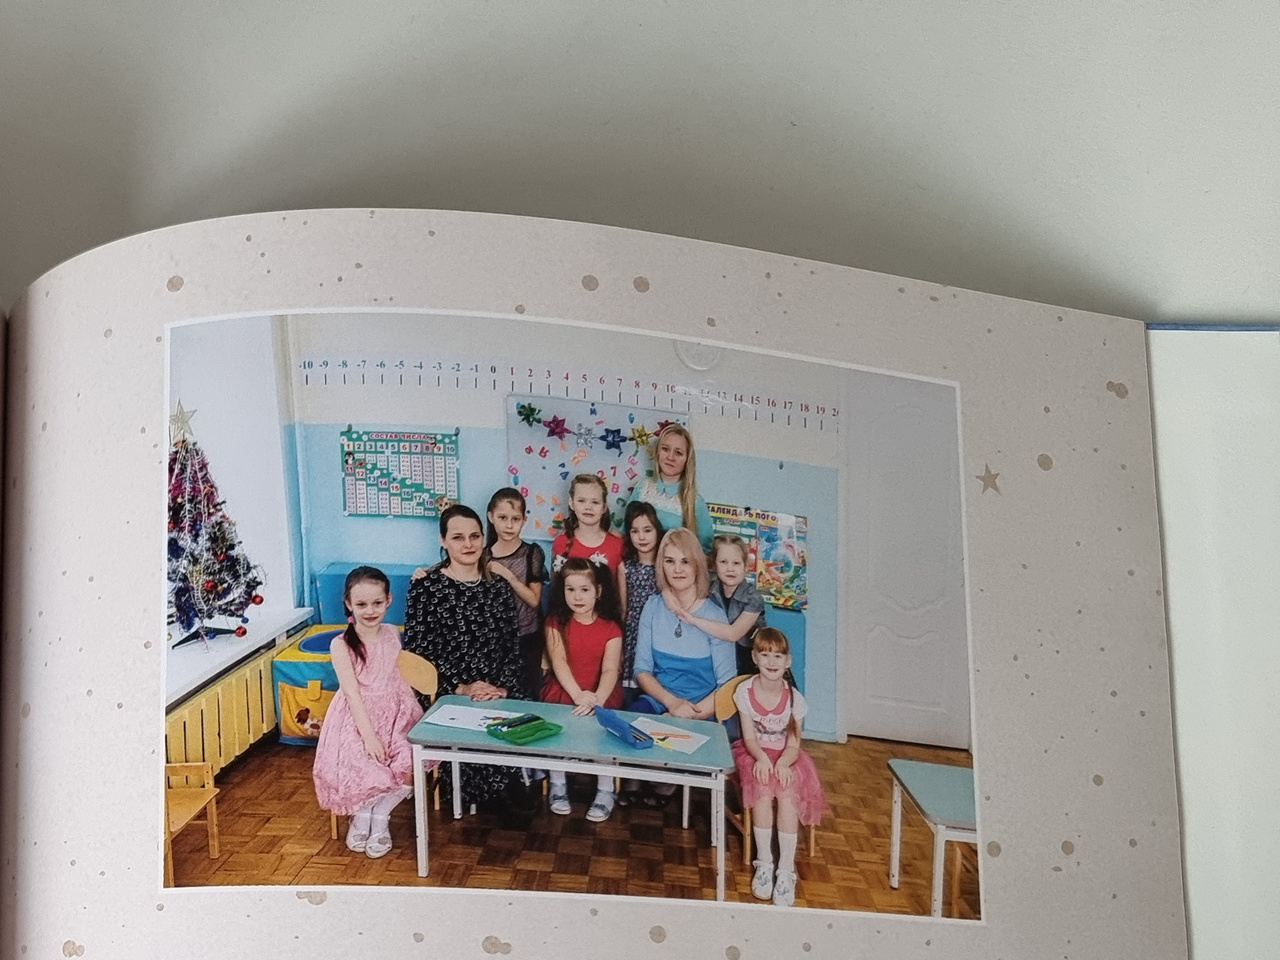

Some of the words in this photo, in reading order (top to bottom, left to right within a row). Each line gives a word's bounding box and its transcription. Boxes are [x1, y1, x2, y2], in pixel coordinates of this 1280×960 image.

[299, 360, 313, 369] -10
[319, 360, 328, 368] -9
[338, 360, 348, 368] -8
[357, 360, 366, 369] -7
[376, 360, 386, 369] -6
[394, 361, 405, 369] -5
[413, 361, 423, 370] -4
[432, 362, 442, 371] -3
[451, 363, 461, 372] -2
[470, 364, 478, 373] -1
[666, 384, 676, 393] 10
[734, 393, 743, 403] 14
[751, 395, 760, 405] 15
[767, 398, 777, 408] 16
[783, 401, 793, 410] 17
[800, 403, 810, 413] 18
[816, 405, 825, 415] 19
